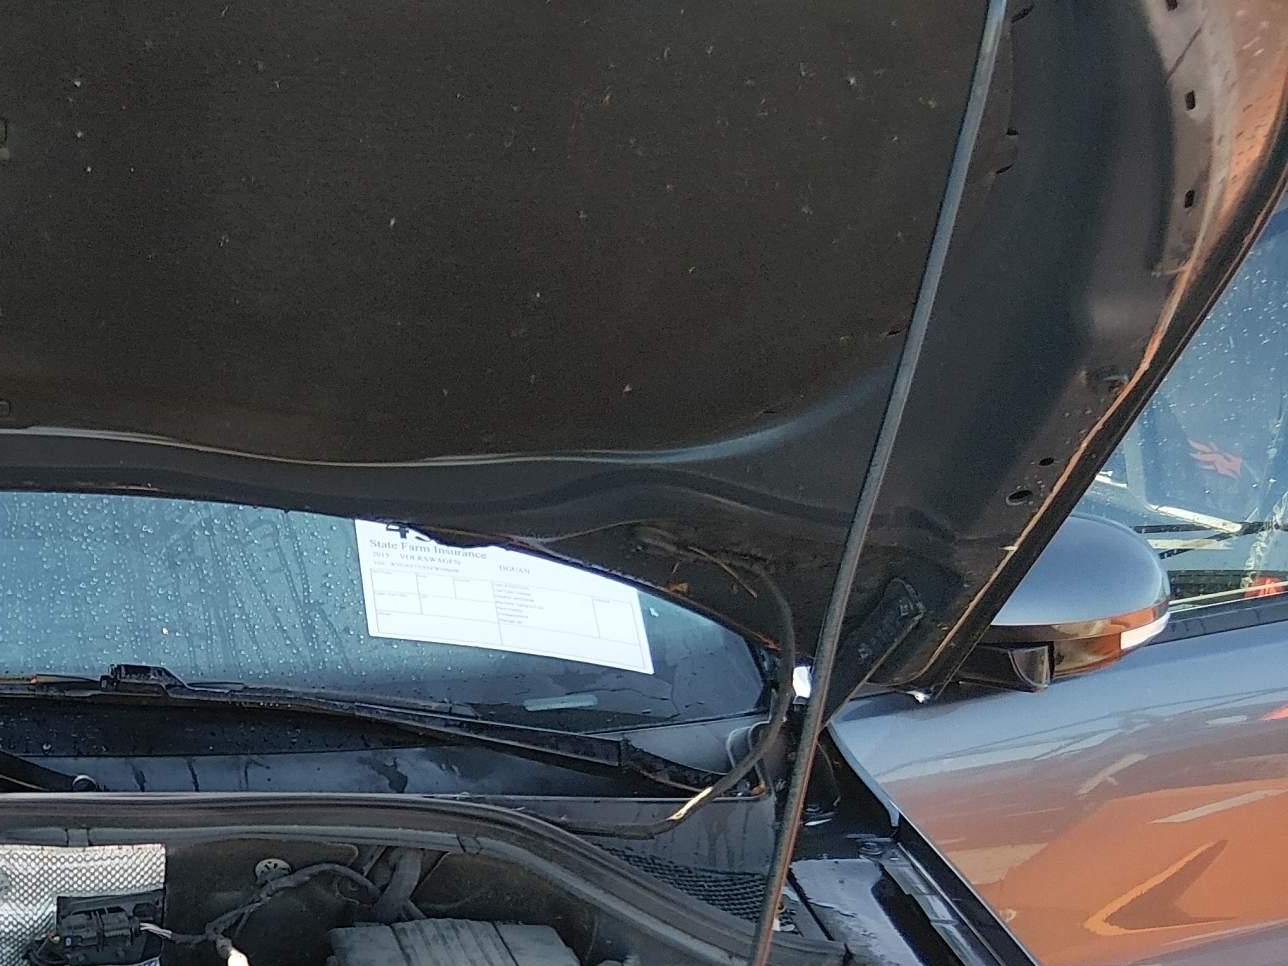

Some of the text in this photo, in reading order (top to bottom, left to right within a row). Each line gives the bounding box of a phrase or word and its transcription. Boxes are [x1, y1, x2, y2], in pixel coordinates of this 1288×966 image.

[369, 538, 487, 559] State Farm Insurance
